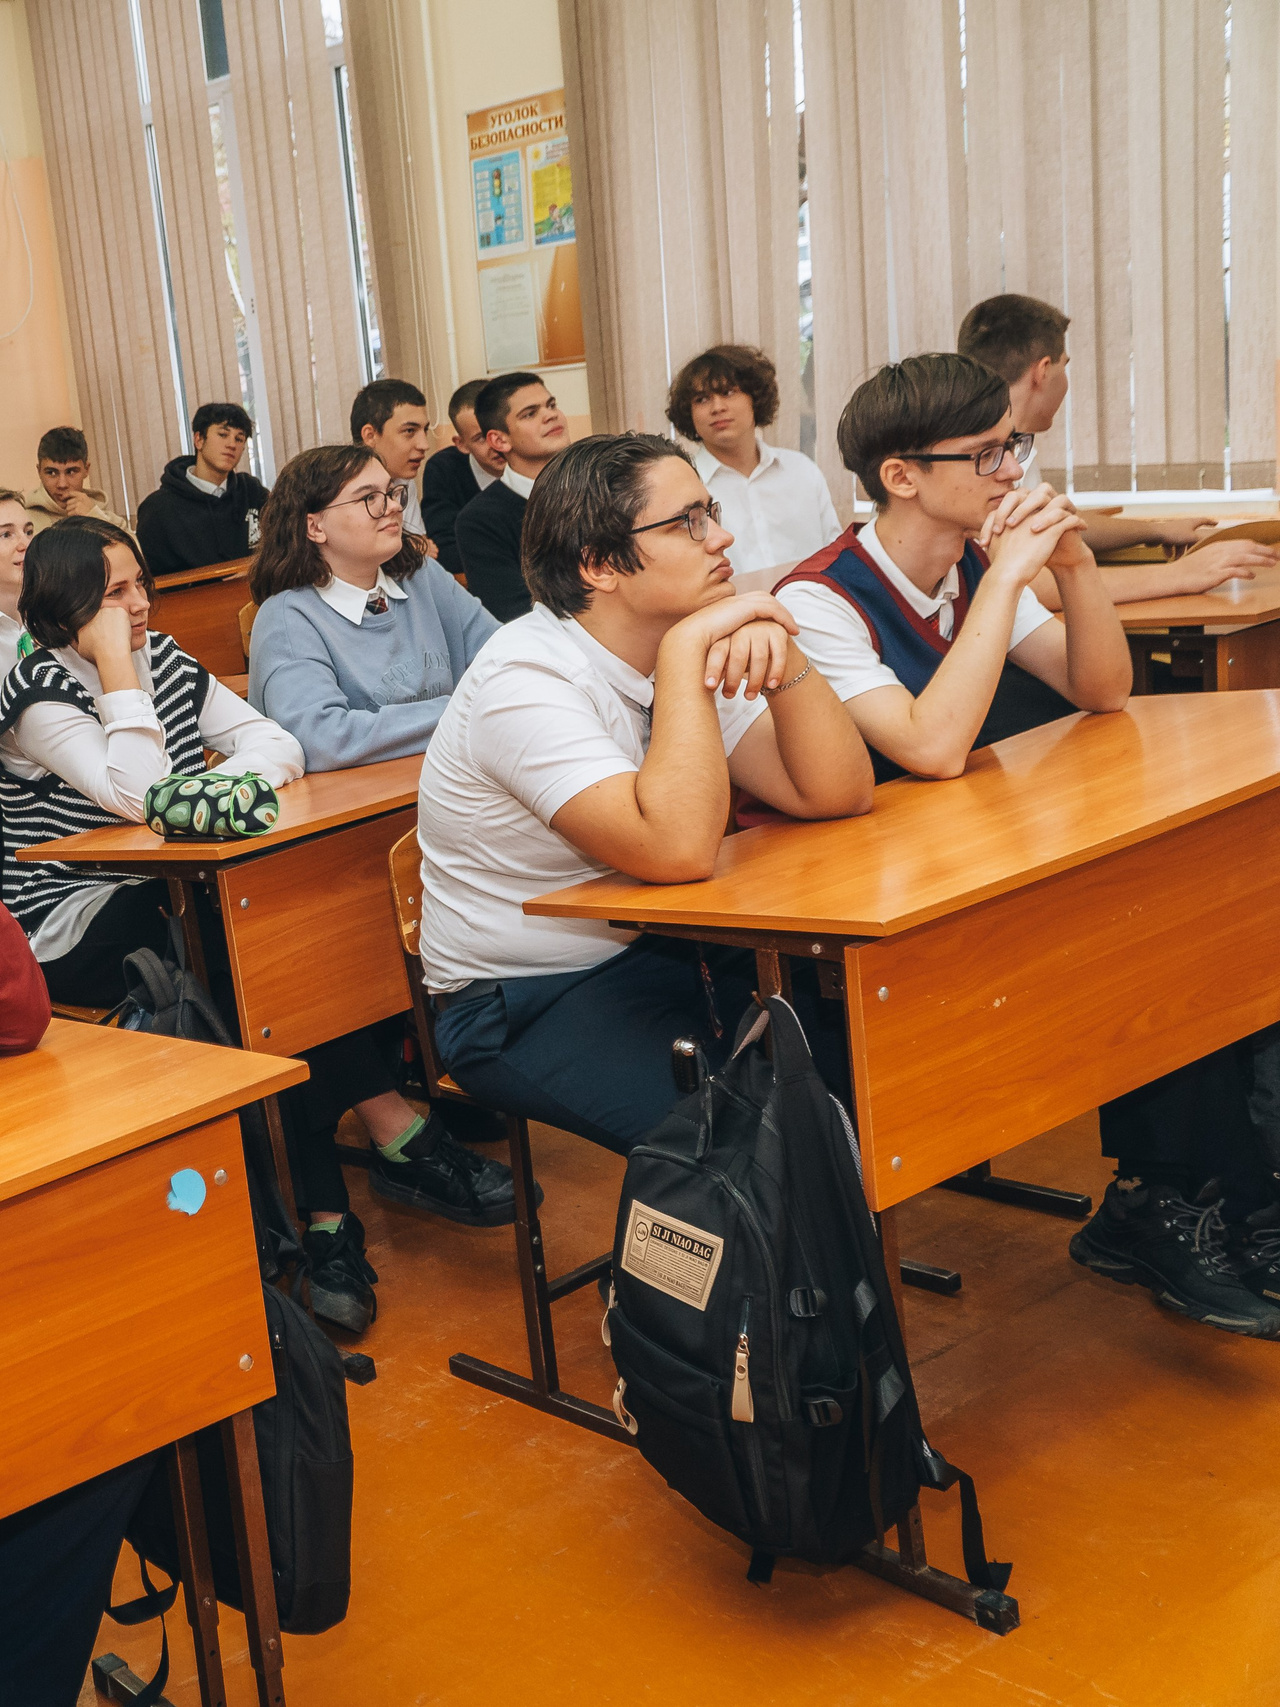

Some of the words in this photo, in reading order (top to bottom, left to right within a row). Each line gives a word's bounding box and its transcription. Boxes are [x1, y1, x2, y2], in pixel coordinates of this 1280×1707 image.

[490, 103, 538, 128] УГОЛОК
[470, 114, 563, 150] БЕЗОПАСНОСТИ
[423, 651, 451, 670] ZON
[651, 1225, 662, 1238] SI
[661, 1229, 671, 1242] JI
[670, 1232, 693, 1251] NIAO
[692, 1242, 712, 1259] BAG
